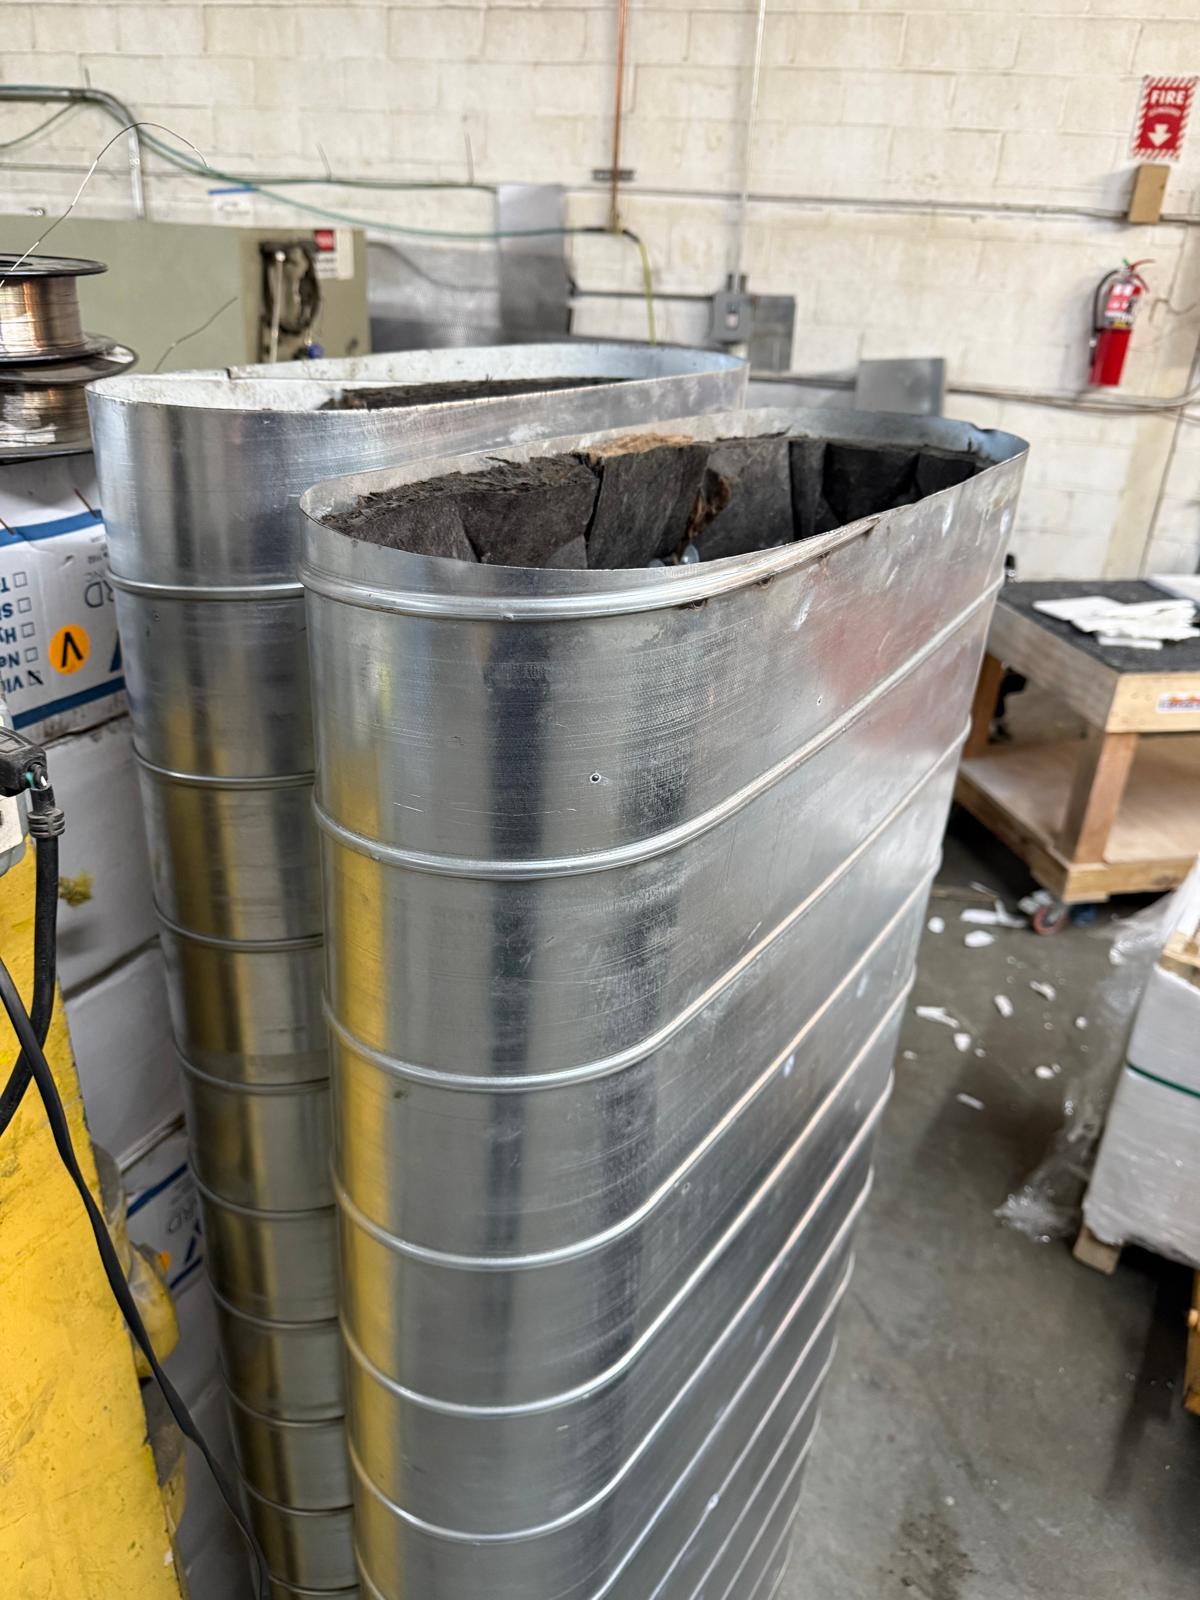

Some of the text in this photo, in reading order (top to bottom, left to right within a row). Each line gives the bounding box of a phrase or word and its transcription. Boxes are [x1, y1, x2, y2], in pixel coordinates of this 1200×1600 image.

[1149, 89, 1187, 106] FIRE
[0, 602, 14, 620] S
[61, 631, 84, 668] V
